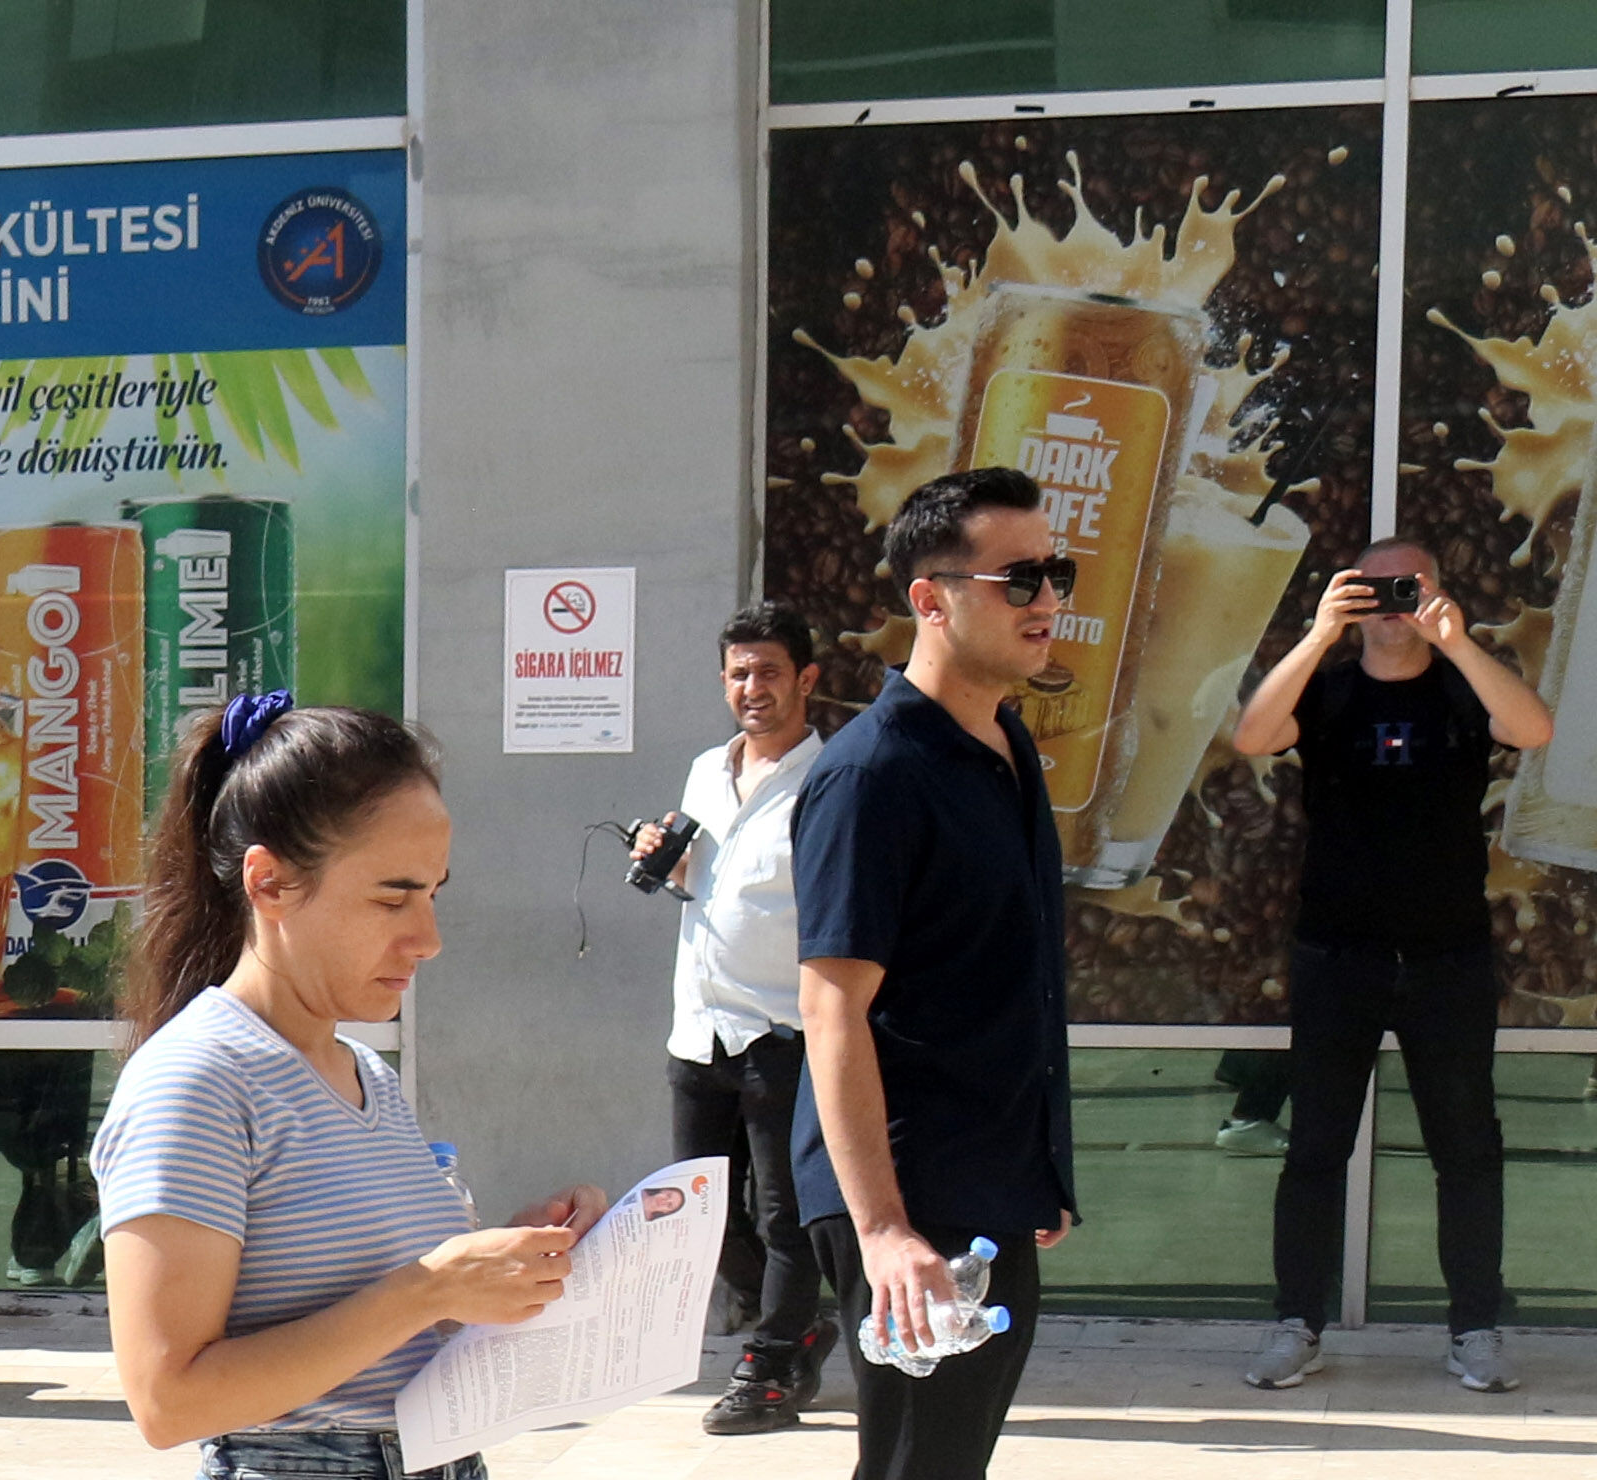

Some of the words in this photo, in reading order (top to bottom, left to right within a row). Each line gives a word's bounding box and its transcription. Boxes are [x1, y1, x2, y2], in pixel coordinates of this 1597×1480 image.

[29, 369, 218, 421] çeşitleriyle
[17, 434, 228, 482] dönüştürün.
[1017, 437, 1119, 492] DARK
[514, 649, 566, 679] SİGARA
[569, 647, 623, 682] İÇİLMEZ
